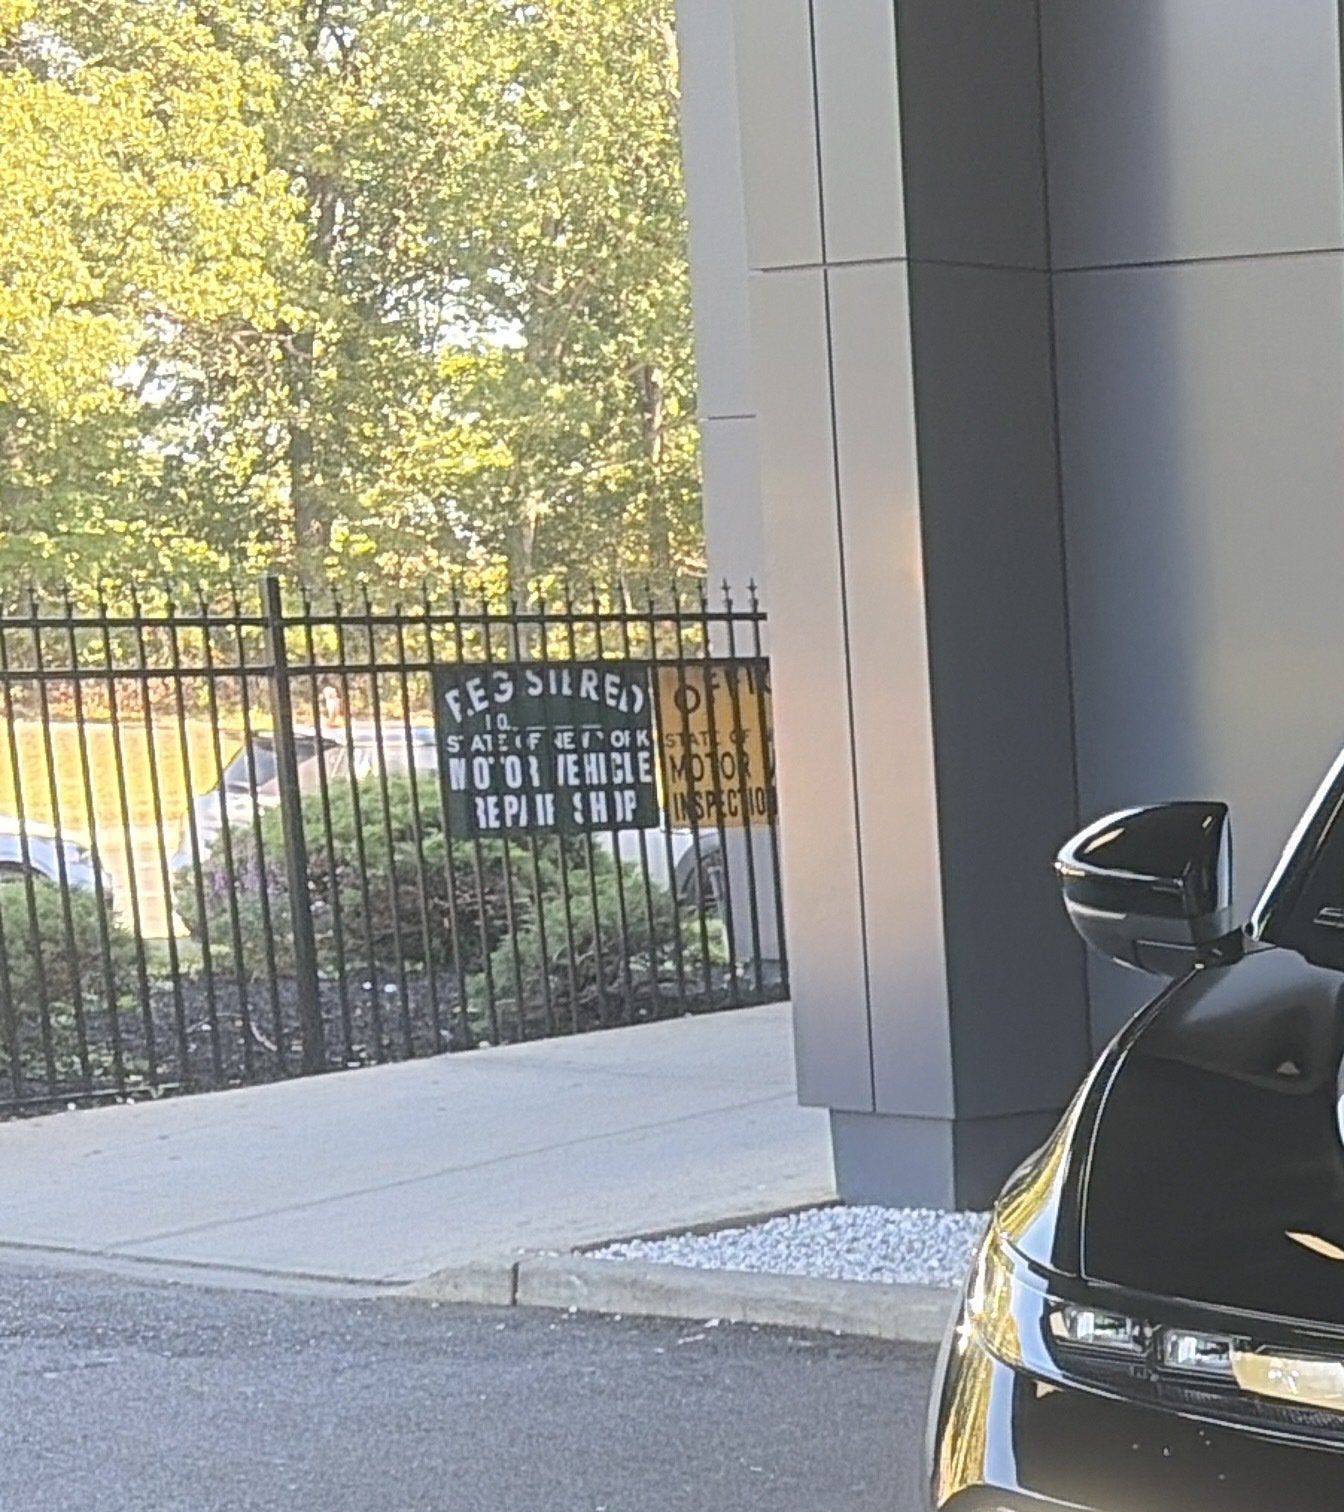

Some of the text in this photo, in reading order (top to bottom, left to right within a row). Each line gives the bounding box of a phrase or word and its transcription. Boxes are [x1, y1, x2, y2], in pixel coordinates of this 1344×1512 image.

[445, 668, 645, 724] REGSTERED
[447, 734, 509, 753] SATE
[448, 755, 540, 791] MOOR
